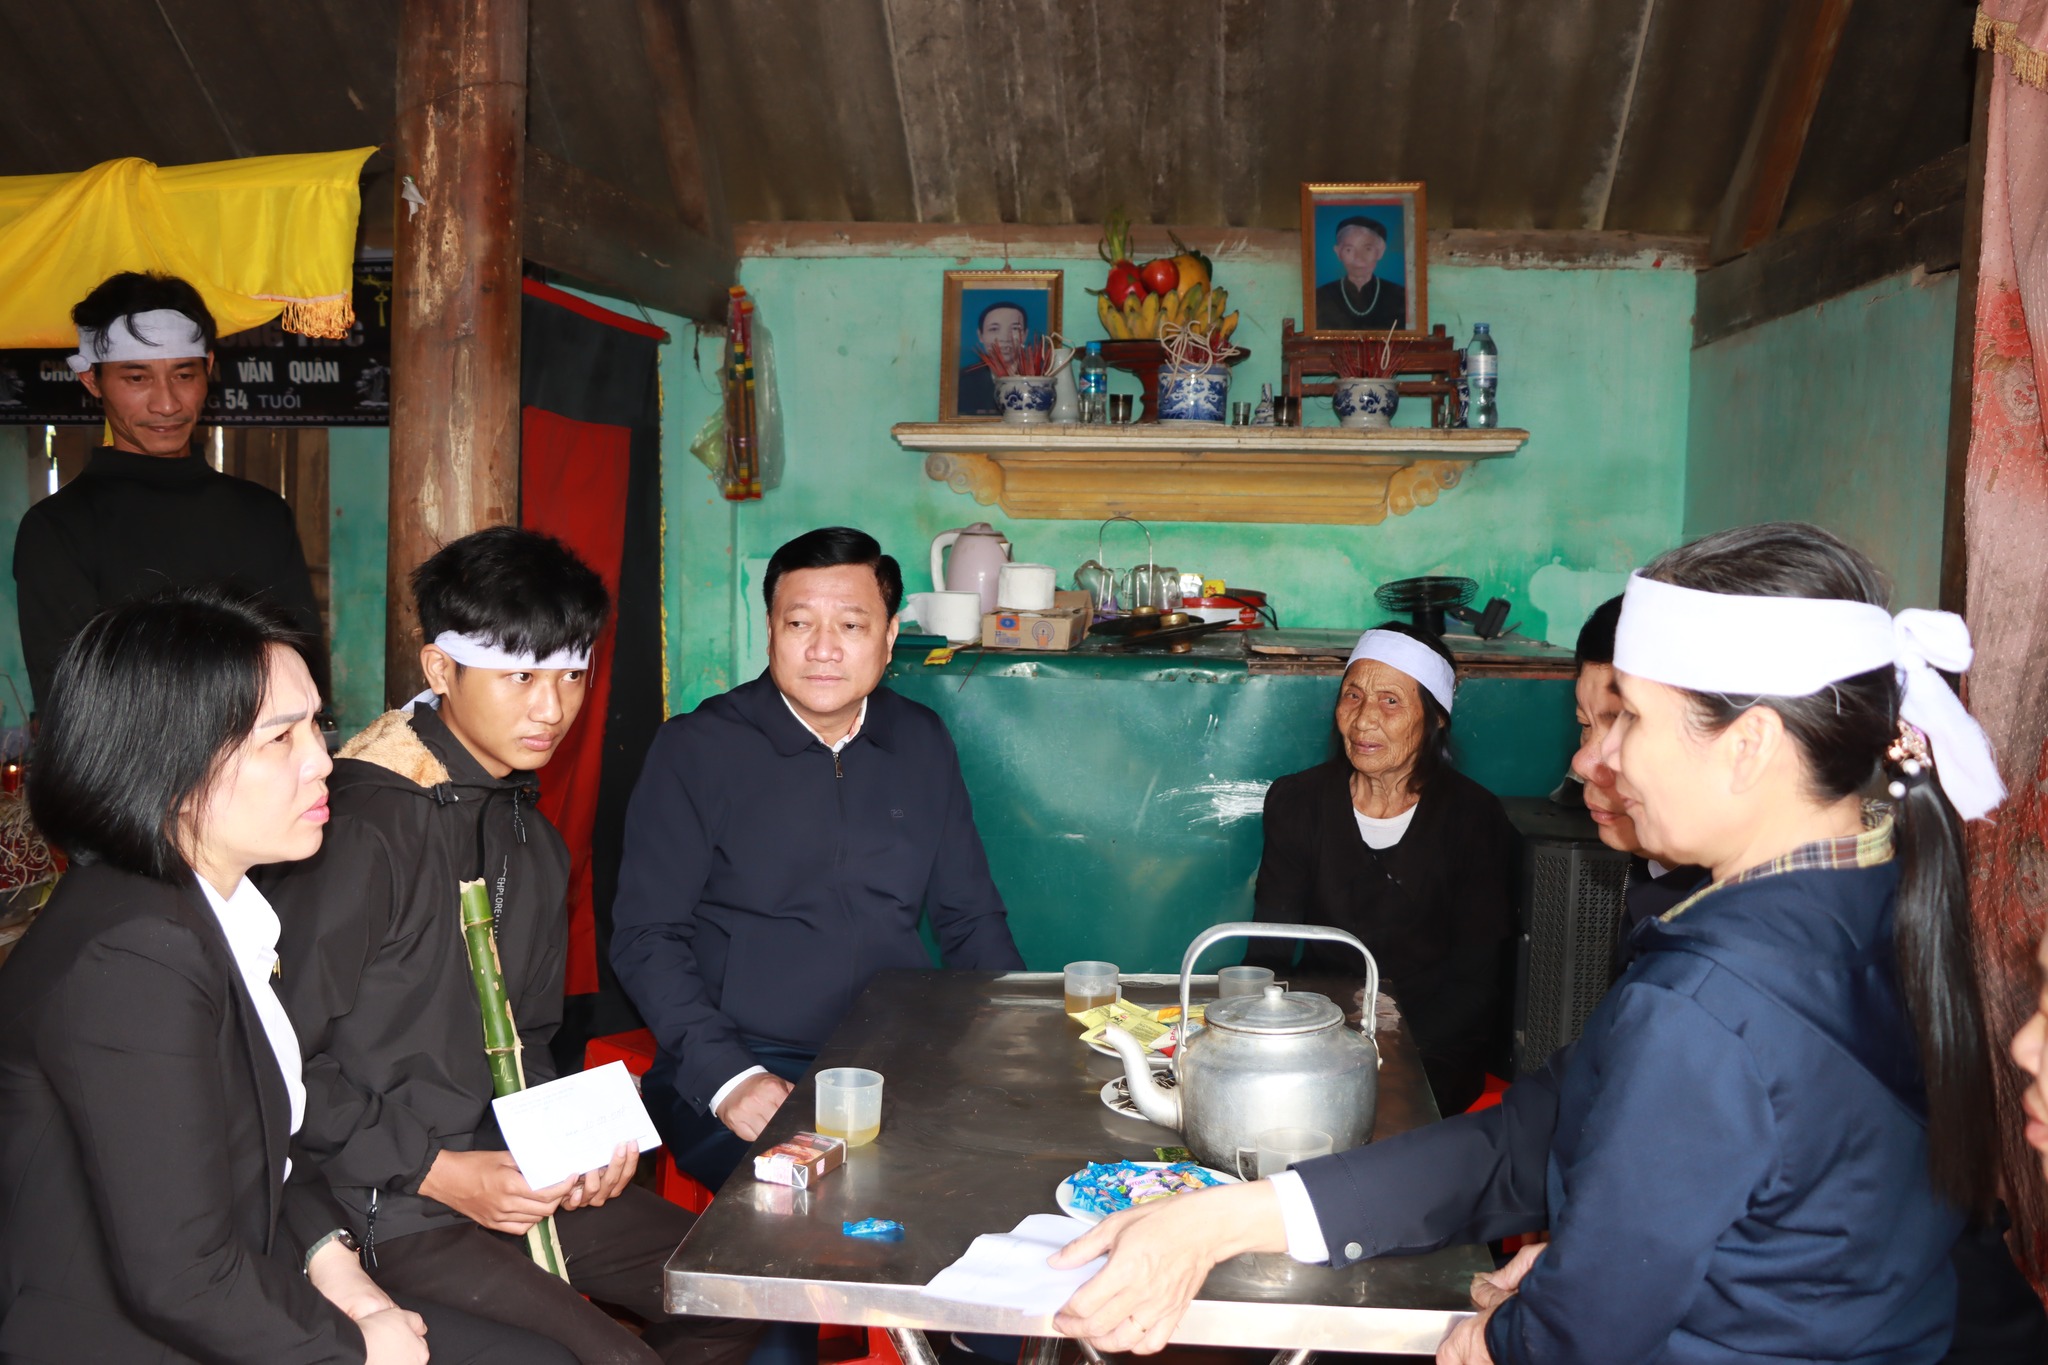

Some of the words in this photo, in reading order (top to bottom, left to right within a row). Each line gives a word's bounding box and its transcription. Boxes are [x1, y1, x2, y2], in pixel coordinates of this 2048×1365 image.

[237, 357, 274, 384] VĂN
[224, 388, 249, 410] 54
[257, 386, 301, 409] TUỔI
